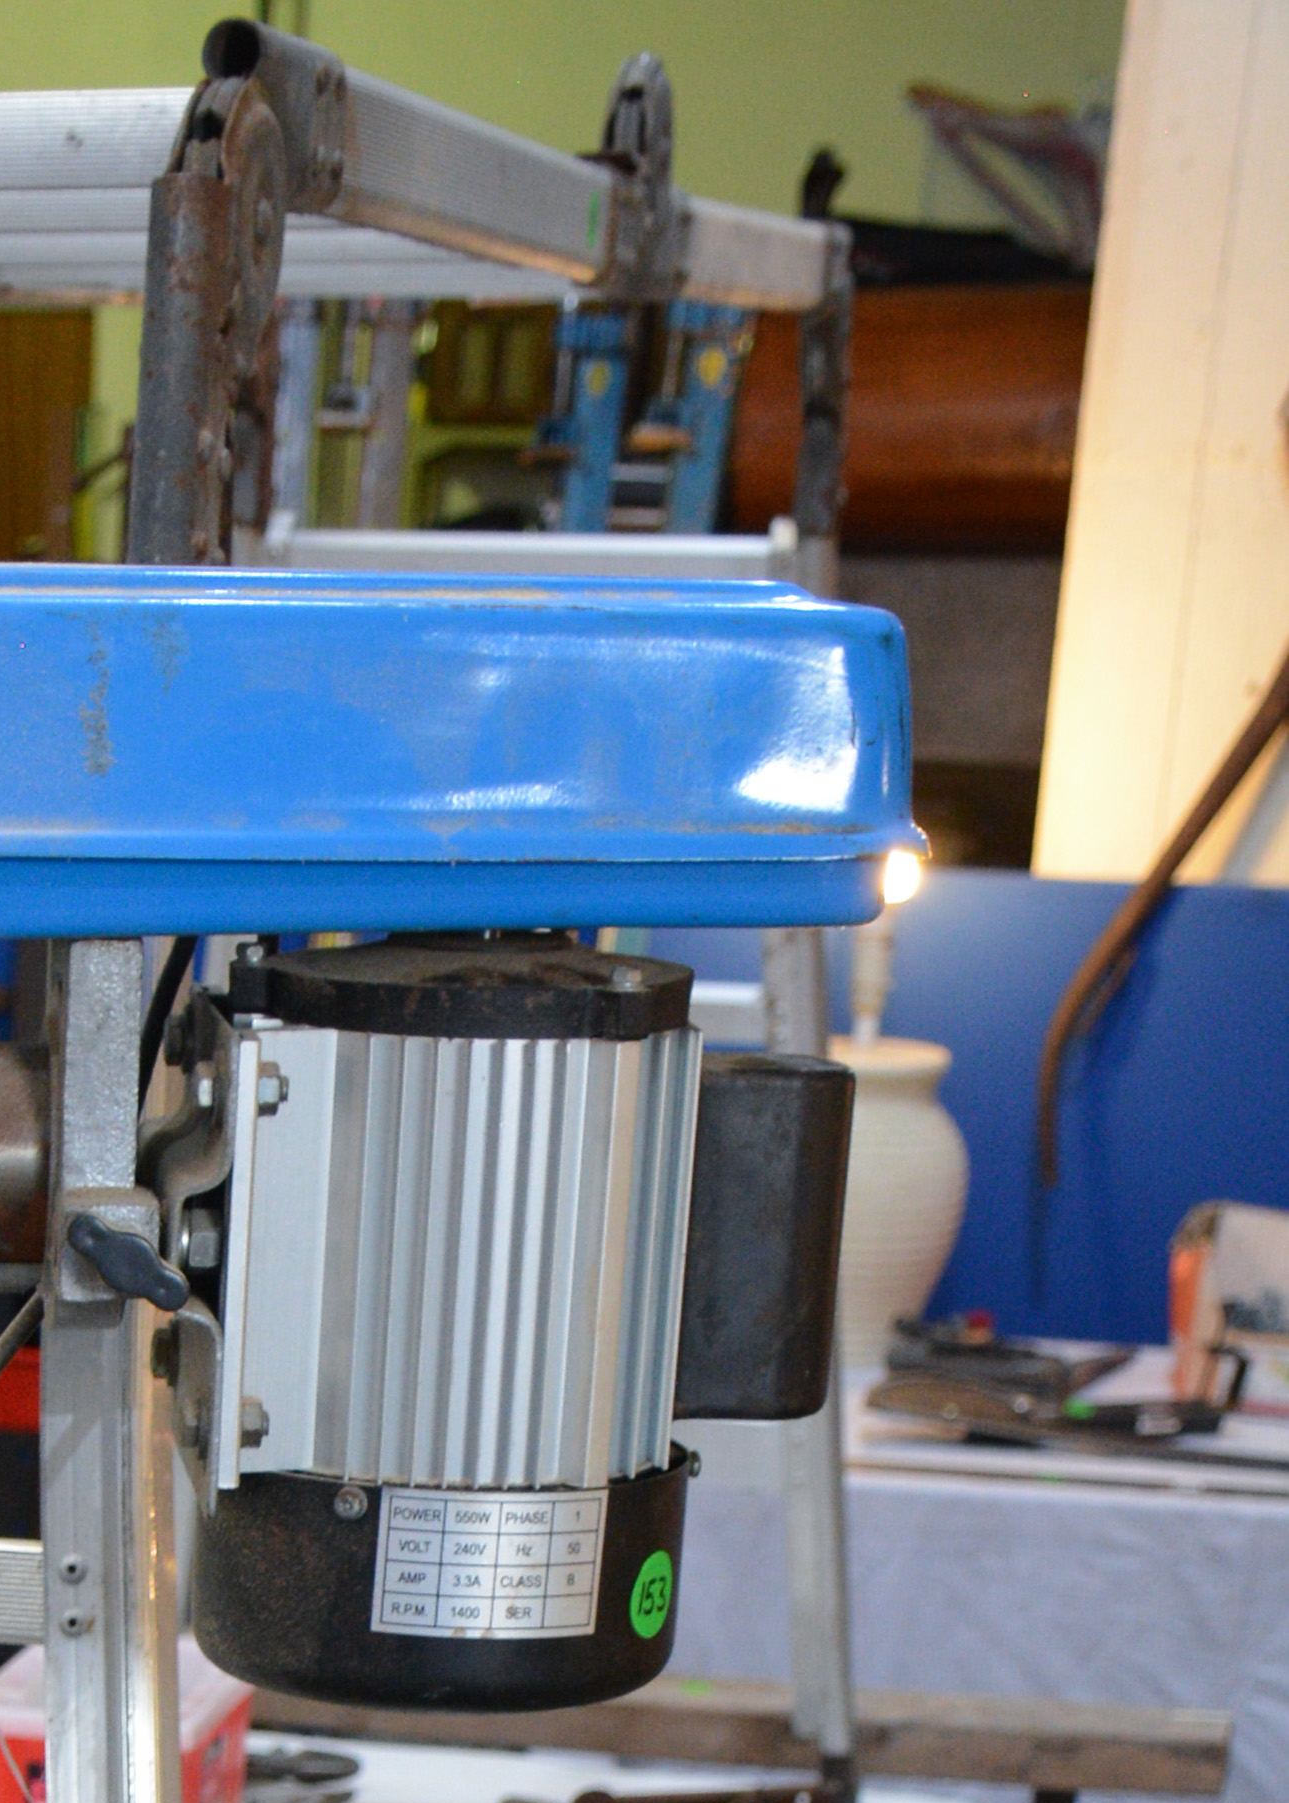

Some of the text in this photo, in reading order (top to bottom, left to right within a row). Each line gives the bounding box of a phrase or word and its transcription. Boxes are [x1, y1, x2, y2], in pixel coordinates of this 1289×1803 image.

[393, 1506, 442, 1523] POWER
[505, 1510, 549, 1526] PHASE
[575, 1510, 581, 1523] 1
[398, 1539, 432, 1555] VOLT
[453, 1542, 486, 1557] 240V
[516, 1542, 533, 1557] Hz
[567, 1541, 581, 1555] 50
[398, 1571, 427, 1585] AMP
[453, 1574, 481, 1588] 3.3A
[500, 1574, 543, 1589] CLASS
[636, 1575, 668, 1617] 153
[390, 1603, 428, 1618] R.P.M.
[450, 1605, 481, 1620] 1400
[505, 1606, 533, 1621] SER
